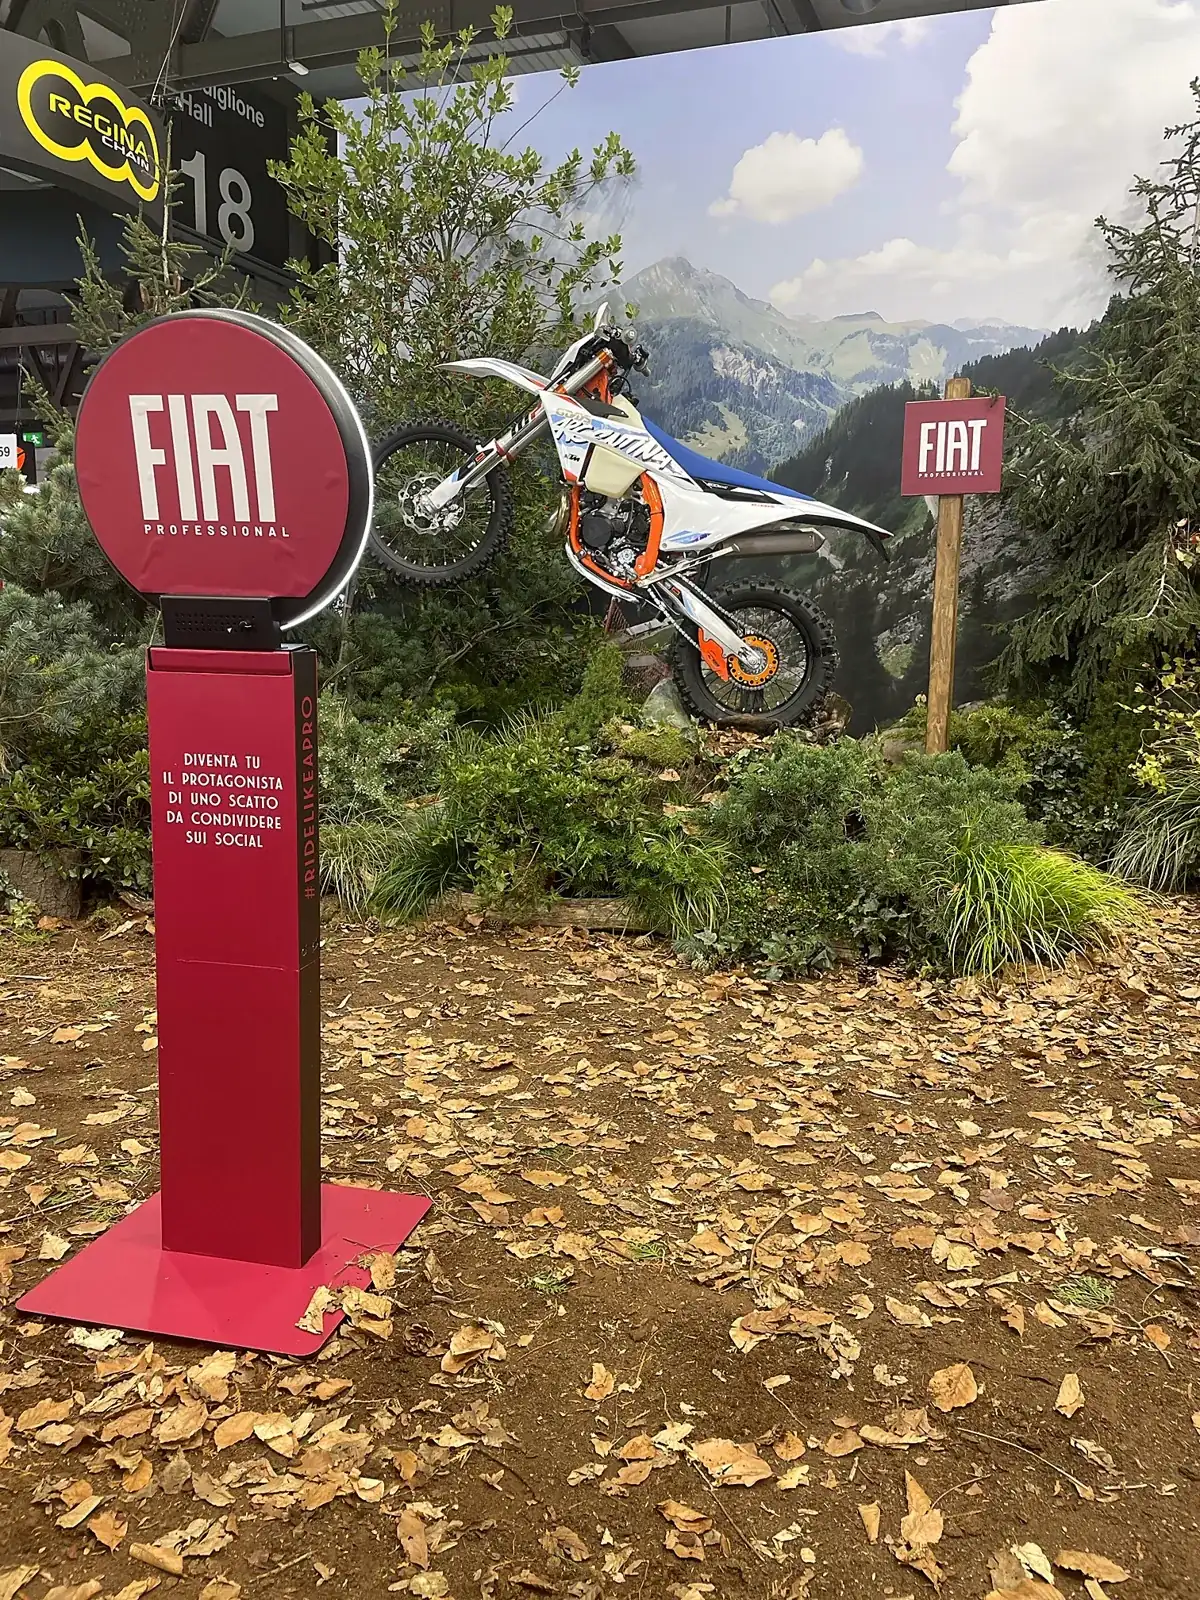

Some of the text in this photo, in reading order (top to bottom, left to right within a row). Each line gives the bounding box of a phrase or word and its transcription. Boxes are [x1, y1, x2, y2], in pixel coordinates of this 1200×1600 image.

[180, 92, 213, 128] Hall
[49, 92, 148, 158] REGINA
[101, 135, 150, 172] CHAIN
[180, 150, 255, 253] 18
[128, 394, 279, 523] FIAT
[918, 419, 988, 473] FIAT
[918, 470, 984, 479] PROFESSIONAL
[144, 523, 291, 538] PROFESSIONAL
[183, 752, 261, 770] DIVENTA TU
[162, 771, 283, 791] IL PROTAGONISTA
[168, 791, 279, 810] DI UNO SCATTO
[301, 695, 316, 900] #RIDELIKEAPRO
[166, 810, 282, 830] DA CONDIVIDERE
[185, 830, 264, 849] SUI SOCIAL
